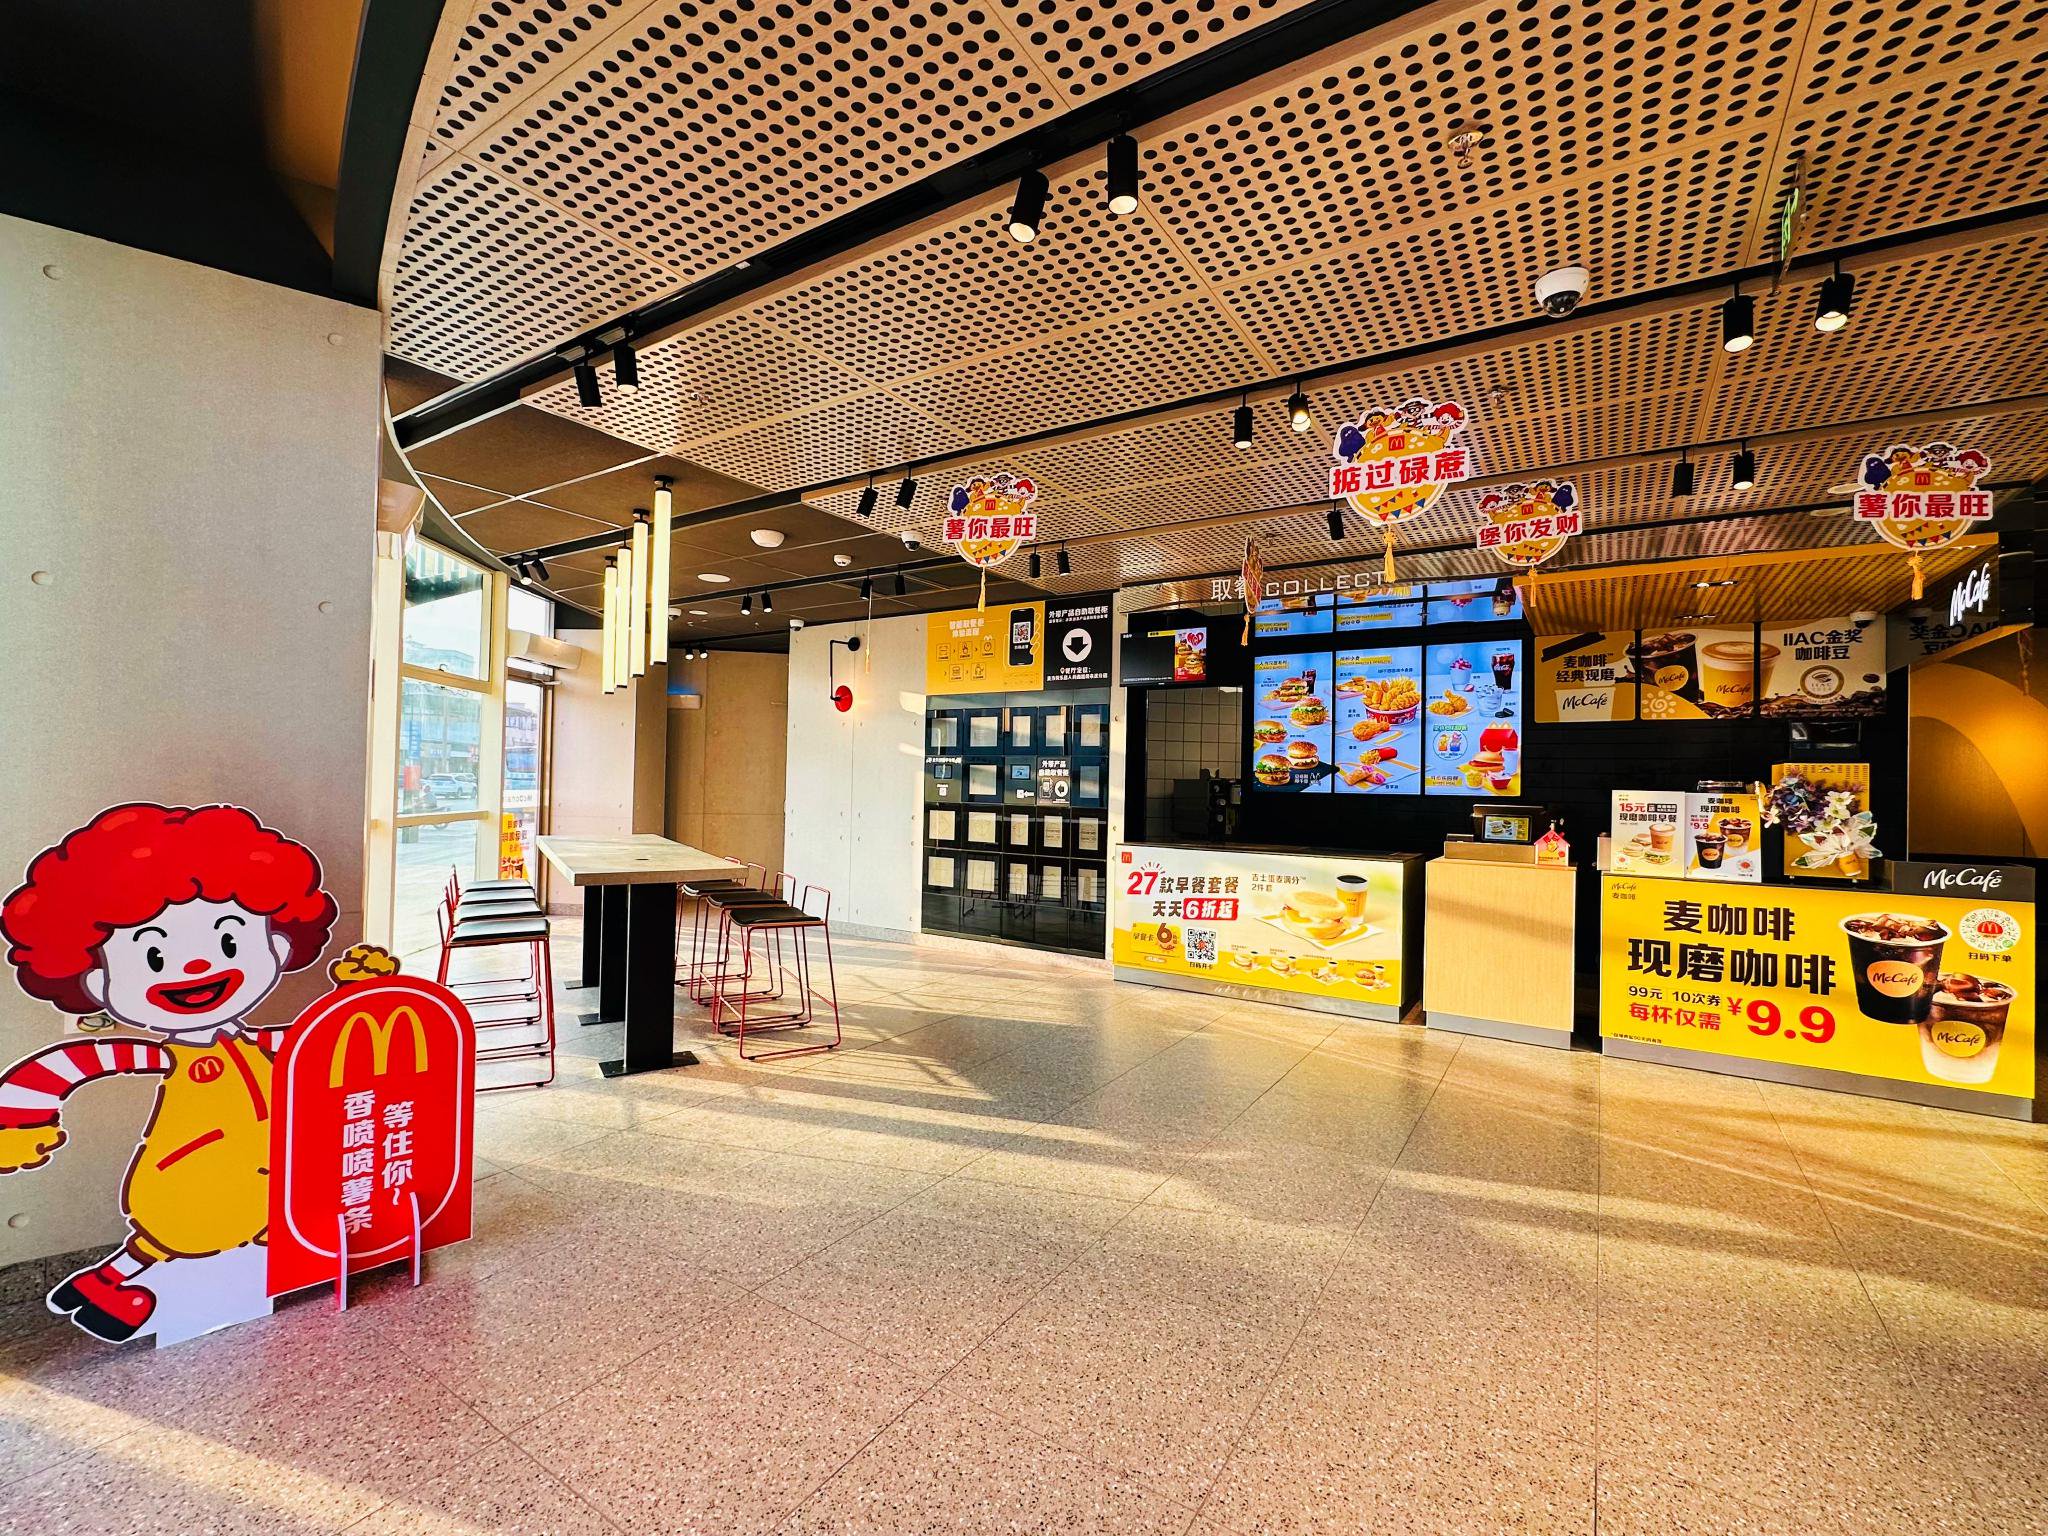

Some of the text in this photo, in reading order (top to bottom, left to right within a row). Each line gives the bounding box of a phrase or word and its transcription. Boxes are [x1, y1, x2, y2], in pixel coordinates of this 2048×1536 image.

[1332, 450, 1466, 496] 掂过碌蔗
[1858, 493, 1990, 518] 薯你最旺
[946, 517, 1034, 540] 薯你最旺
[1478, 513, 1580, 549] 堡你发财
[1265, 571, 1386, 597] COLLECT
[1795, 645, 1850, 661] 咖啡豆
[1556, 668, 1615, 683] 经典现磨
[1619, 802, 1647, 813] 15元
[1923, 868, 2003, 893] McCafé
[1663, 900, 1796, 941] 麦咖啡
[1627, 937, 1837, 996] 现磨咖啡
[1968, 952, 2012, 962] 扫码下单
[1872, 972, 1919, 986] McCafé
[1628, 985, 1721, 1007] 99元 10次券
[1629, 1001, 1722, 1031] 每杯仅需
[1937, 1031, 1981, 1047] McCafé
[341, 1090, 376, 1235] 香喷喷薯条
